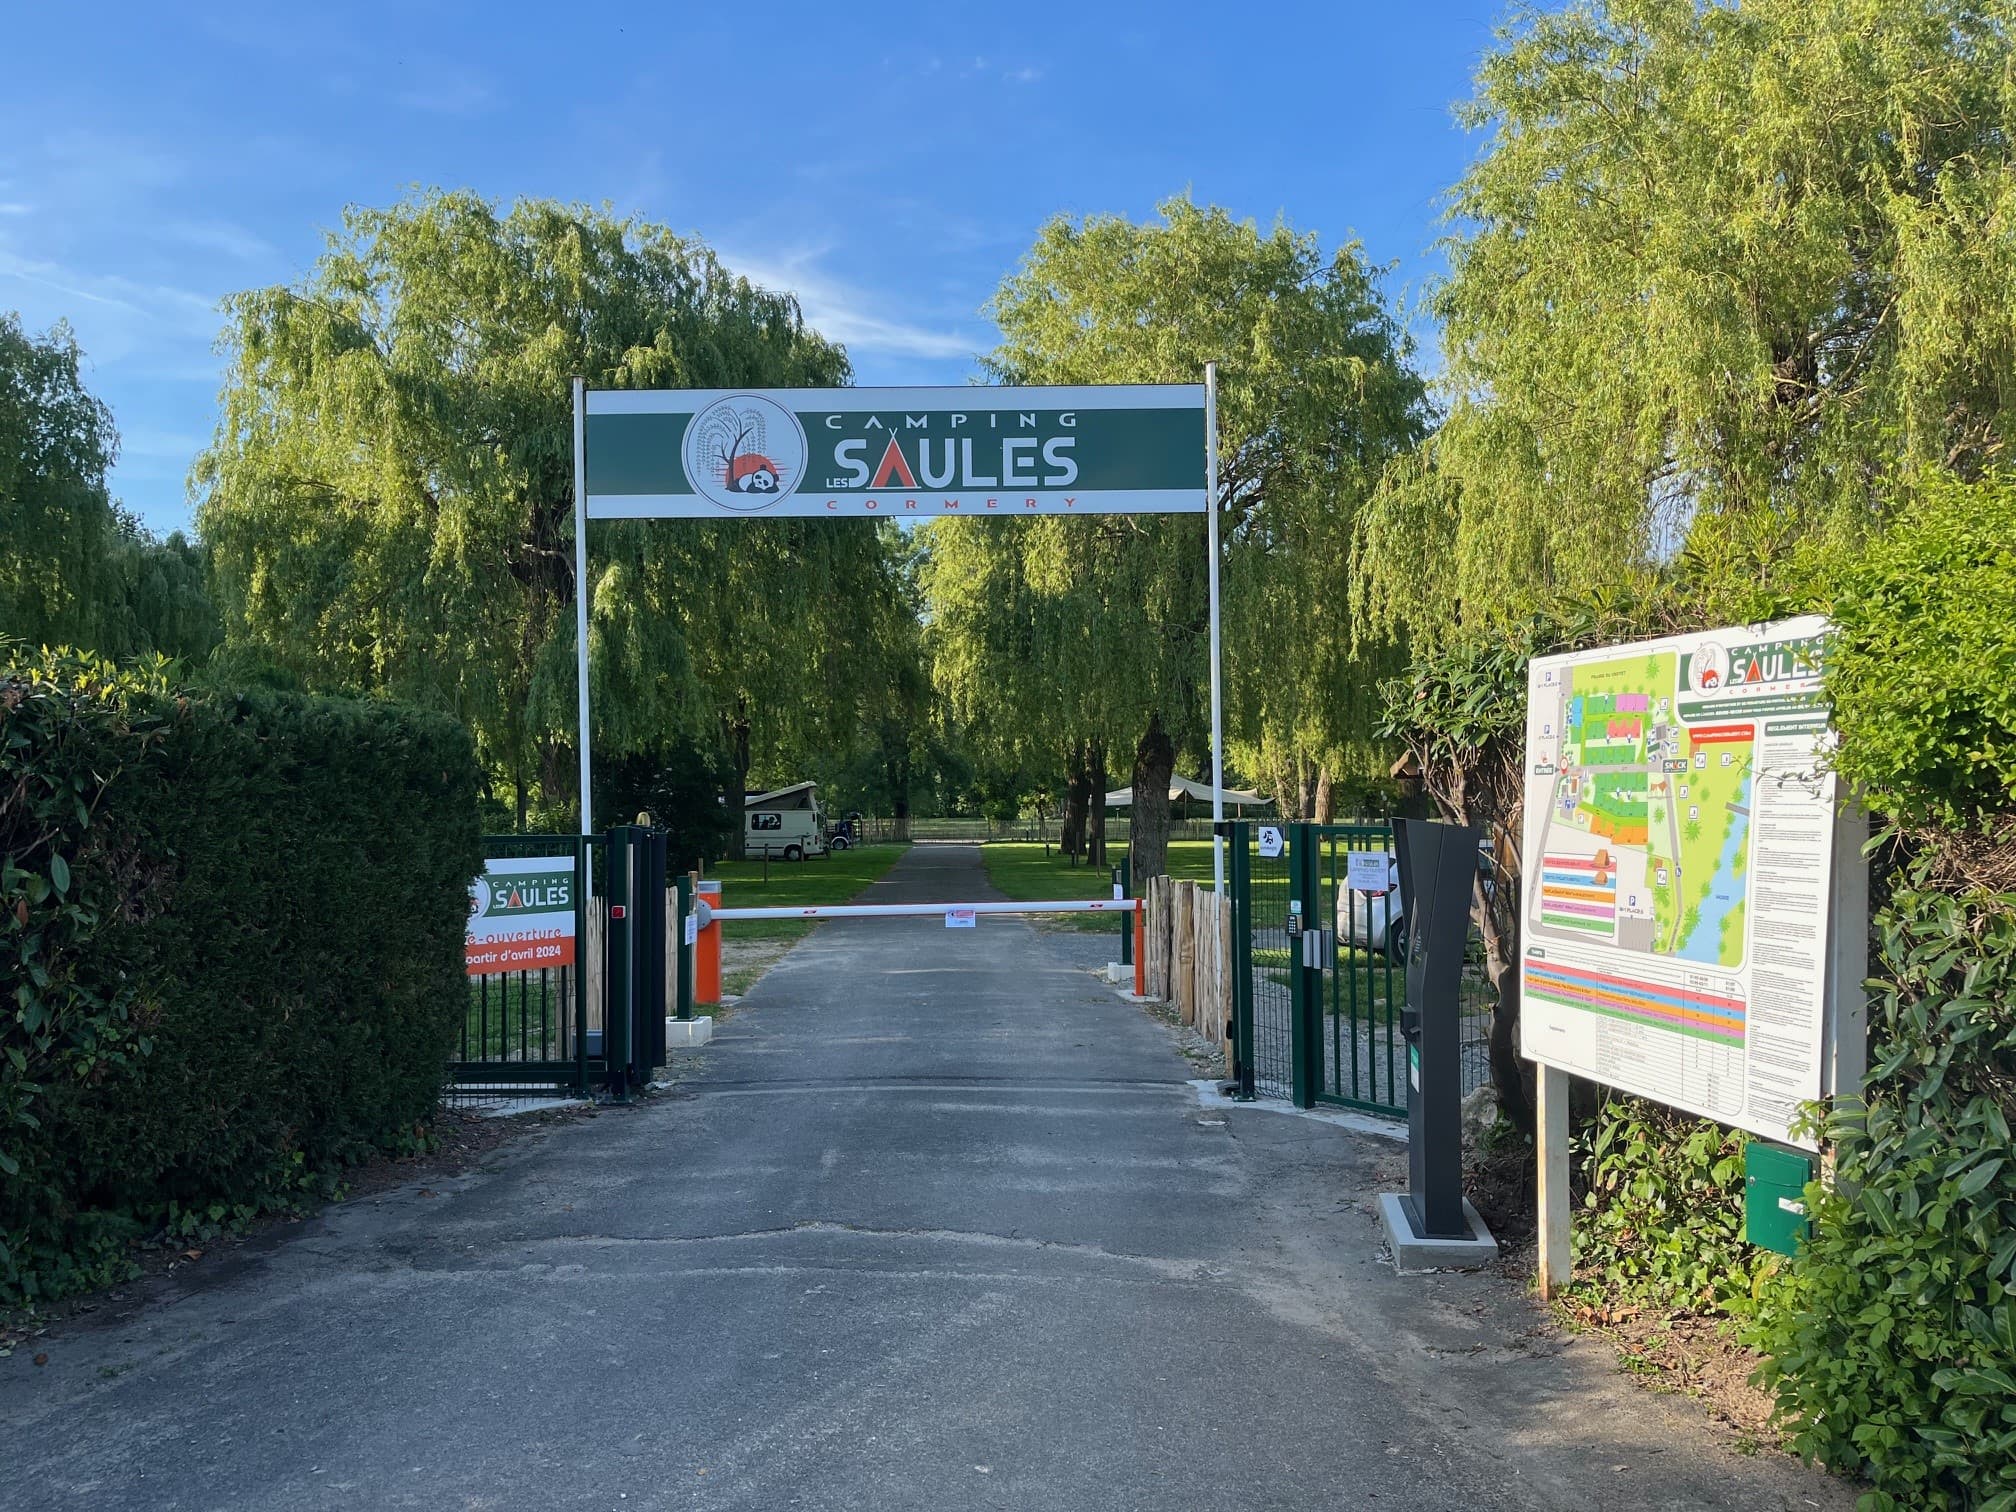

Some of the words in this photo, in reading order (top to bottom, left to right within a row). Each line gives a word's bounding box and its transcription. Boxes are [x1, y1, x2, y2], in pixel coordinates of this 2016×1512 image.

[825, 412, 1077, 430] CAMPING
[833, 427, 1079, 489] SAULES
[826, 478, 848, 488] LES
[826, 498, 1076, 510] CORMERY
[1731, 636, 1824, 656] CAMPING
[1729, 682, 1808, 695] CORMER
[493, 877, 569, 888] CAMPING
[495, 886, 569, 909] SAULES
[467, 928, 562, 944] é-ouverture
[500, 948, 533, 962] d'avril
[536, 945, 561, 957] 2024
